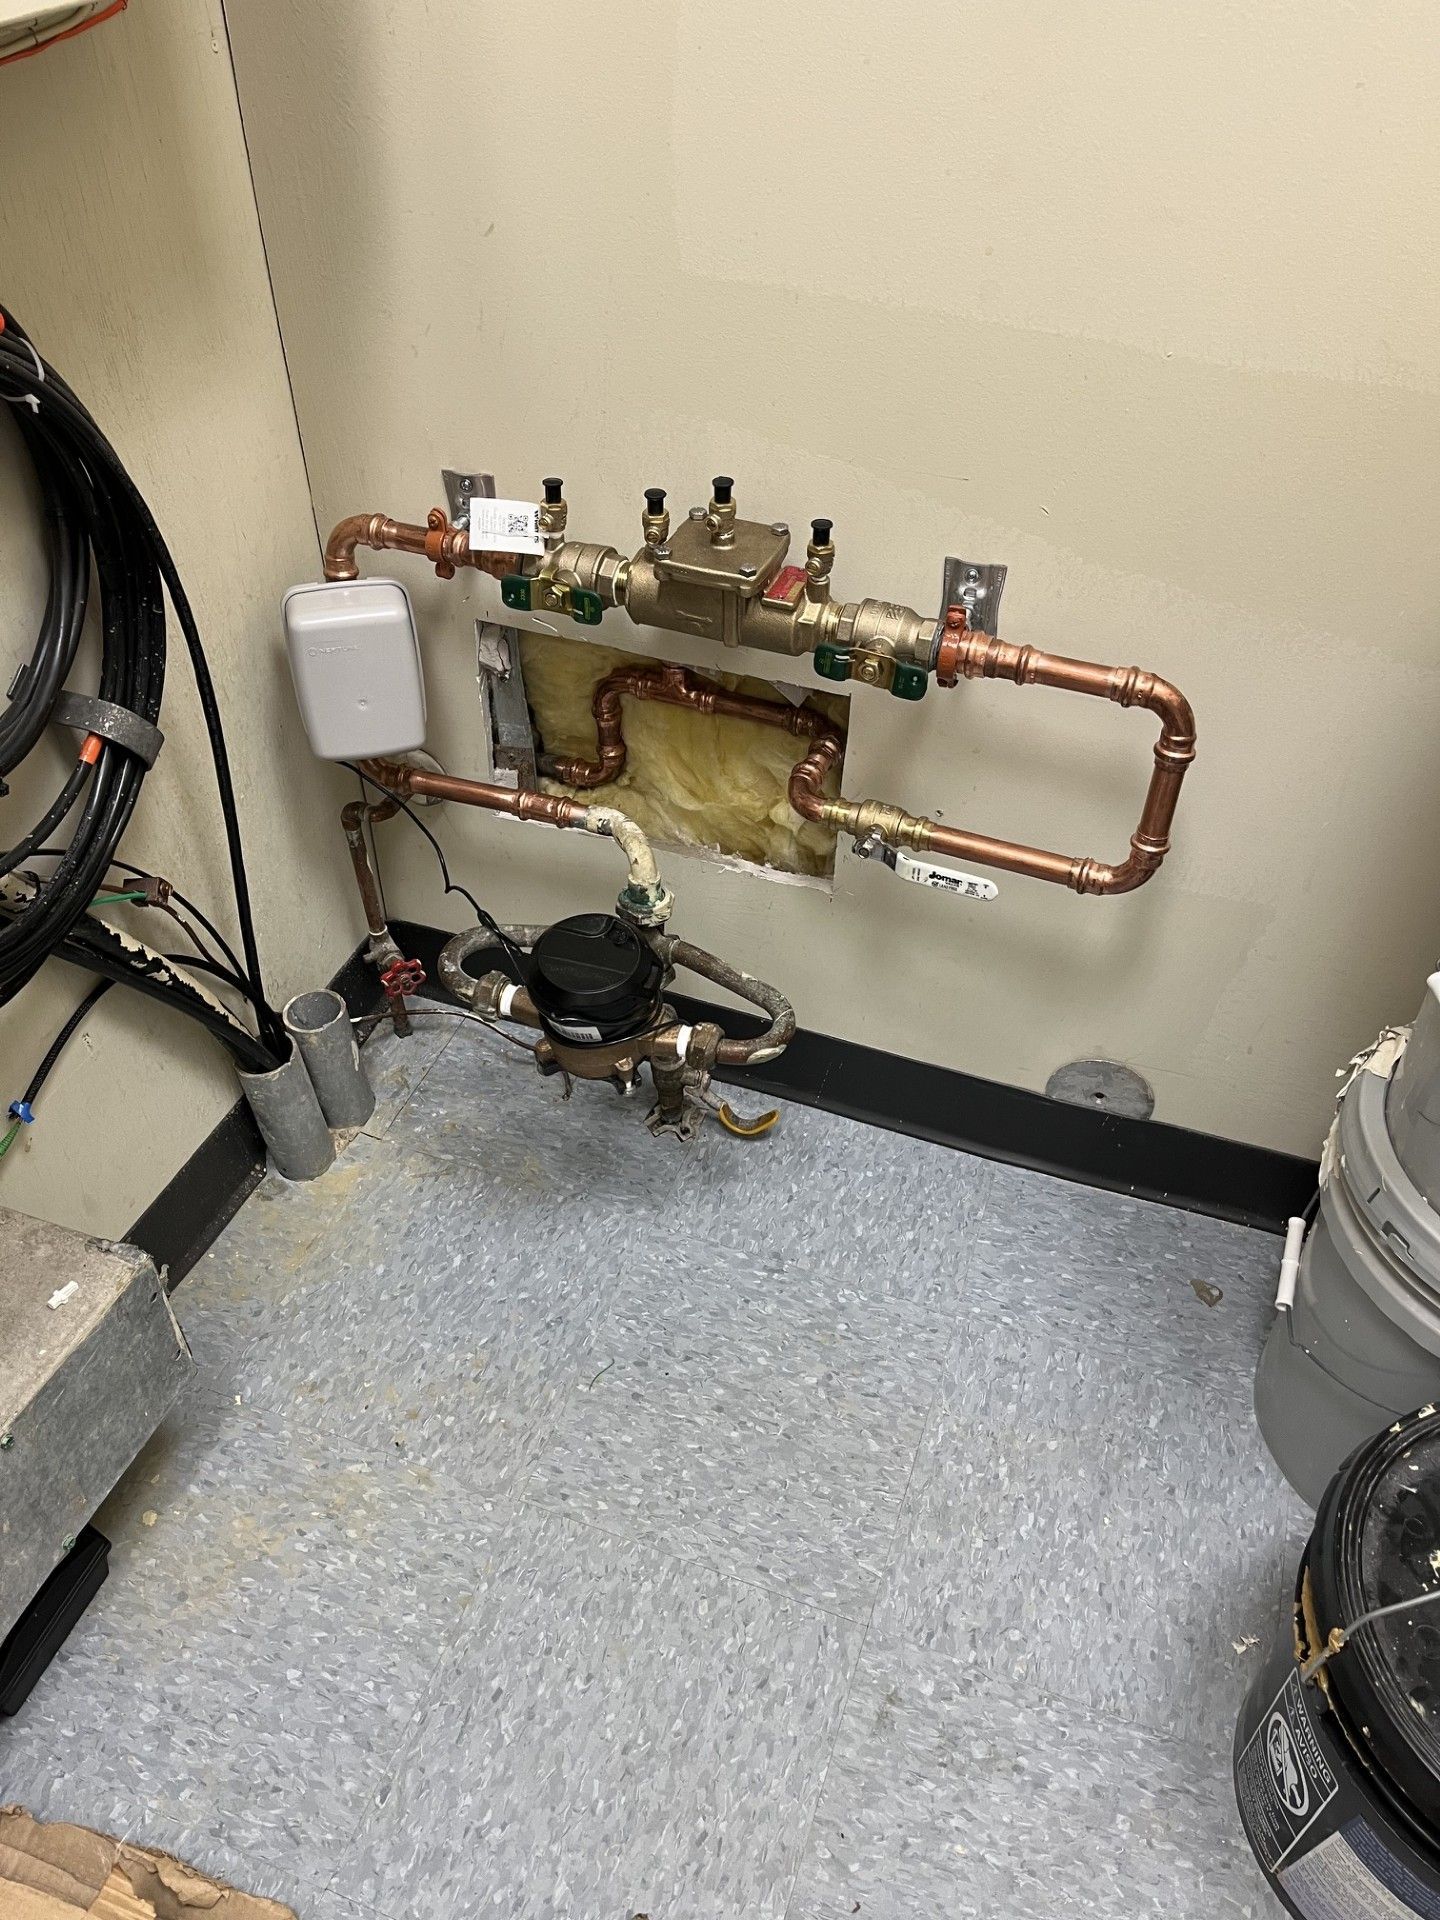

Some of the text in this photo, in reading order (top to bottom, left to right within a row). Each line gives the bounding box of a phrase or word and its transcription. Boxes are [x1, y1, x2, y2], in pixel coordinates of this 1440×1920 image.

[929, 871, 962, 884] Jomar
[1295, 1728, 1318, 1779] AVISO
[1297, 1698, 1332, 1784] WARNING
